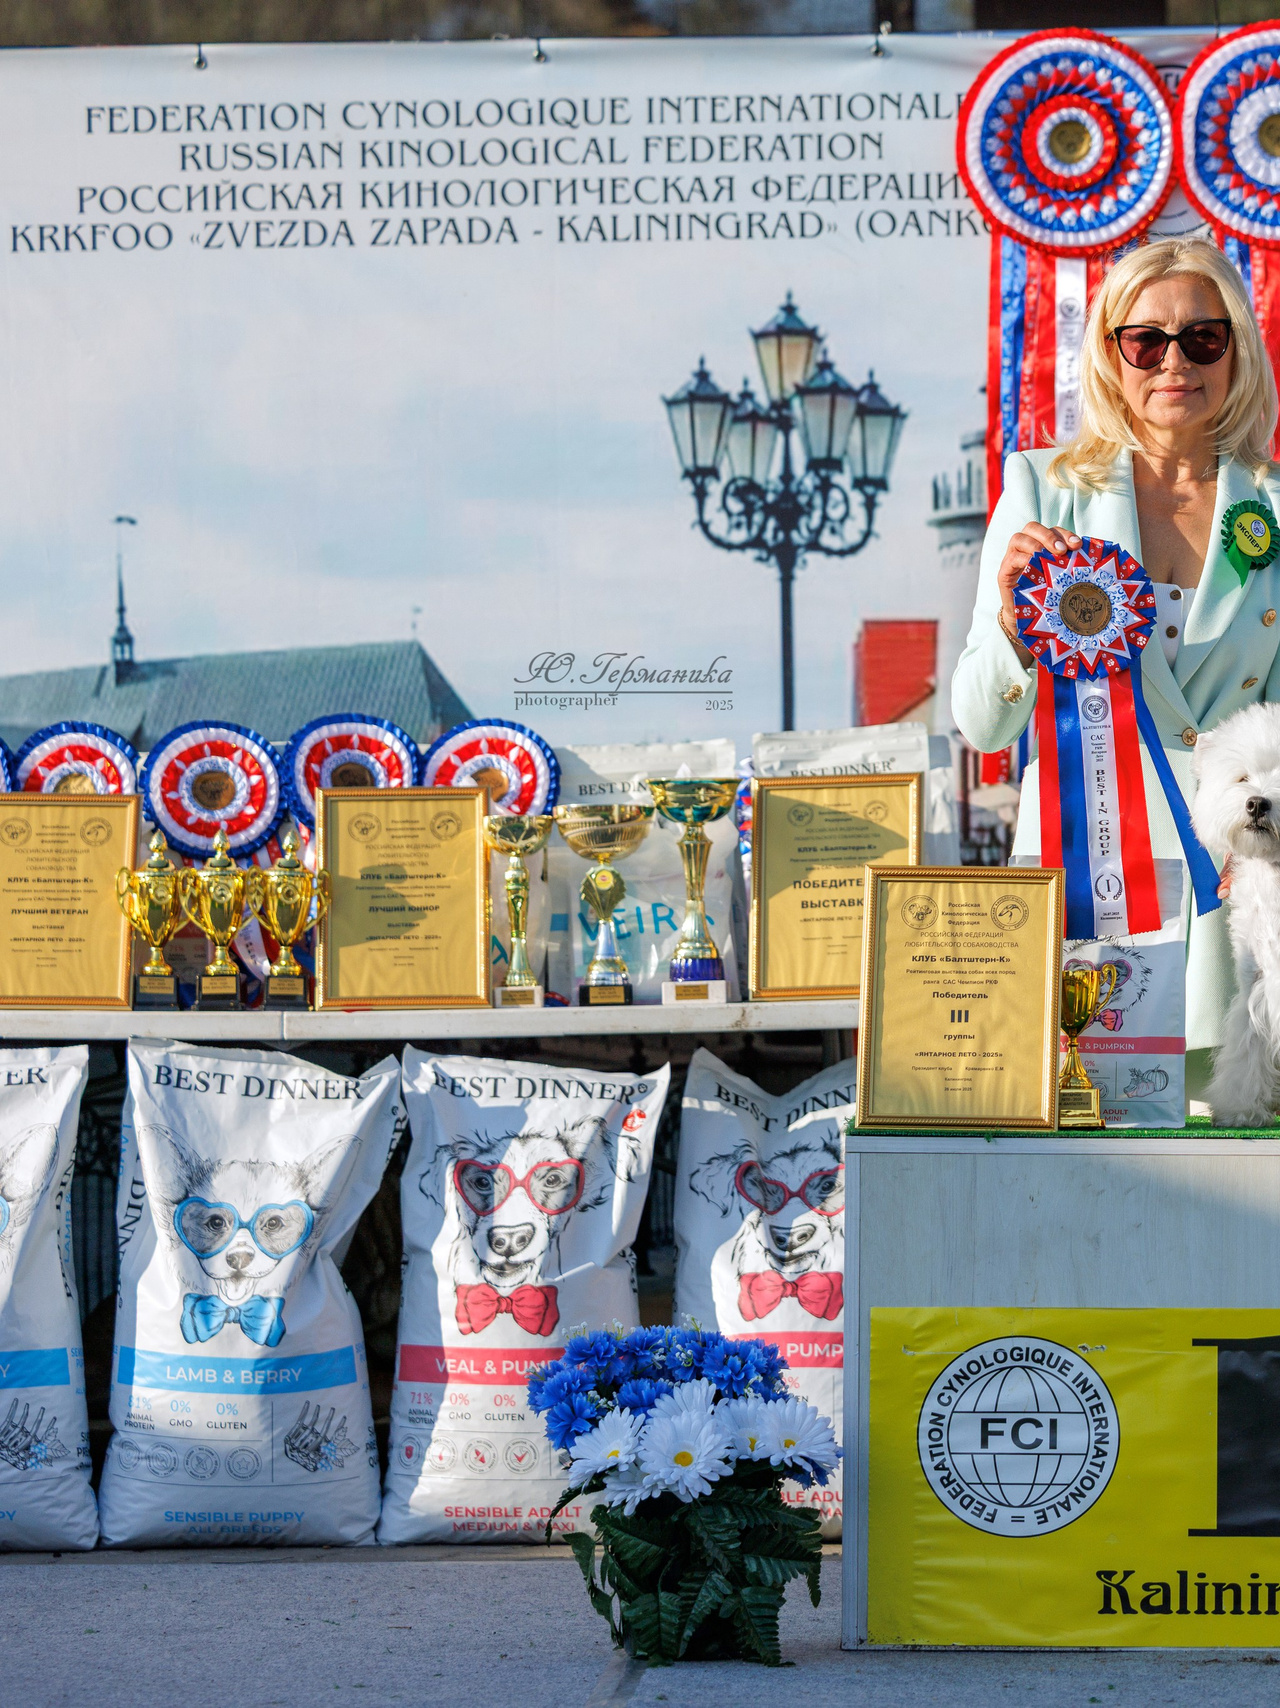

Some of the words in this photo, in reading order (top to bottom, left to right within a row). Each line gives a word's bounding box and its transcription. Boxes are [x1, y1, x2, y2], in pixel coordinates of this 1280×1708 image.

[86, 102, 327, 134] FEDERATION
[343, 96, 632, 133] CYNOLOGIQUE
[180, 142, 345, 172] RUSSIAN
[360, 136, 628, 169] KINOLOGICAL
[643, 132, 884, 164] FEDERATION
[78, 179, 343, 215] РОССИЙСКАЯ
[360, 173, 735, 211] КИНОЛОГИЧЕСКАЯ
[751, 173, 971, 206] ФЕДЕРАЦИ
[11, 223, 174, 253] KRKFOO
[190, 219, 356, 250] «ZVEZDA
[370, 216, 519, 247] ZAPADA
[557, 211, 838, 243] KALININGRAD»
[1236, 521, 1263, 553] ЭКСПЕРТ
[833, 760, 894, 776] DINNER
[578, 783, 617, 796] BEST
[1095, 770, 1106, 795] BEST
[1098, 802, 1108, 814] IN
[1098, 820, 1110, 856] GROUP
[793, 878, 864, 889] ПОБЕДИТЕ
[11, 907, 48, 915] ЛУЧШИЙ
[947, 919, 980, 927] Федерация
[964, 931, 1004, 939] ФЕДЕРАЦИЯ
[904, 941, 961, 949] ЛЮБИТЕЛЬСКОГО
[962, 941, 1019, 949] СОБАКОВОДСТВА
[911, 955, 937, 963] КЛУБ
[939, 955, 1011, 964] «Балтштерн-К»
[932, 991, 989, 999] Победитель
[950, 1009, 970, 1023] III
[943, 1033, 975, 1041] группы
[152, 1064, 234, 1095] BEST
[242, 1075, 364, 1100] DINNER
[433, 1071, 507, 1098] BEST
[515, 1077, 636, 1105] DINNER
[714, 1082, 777, 1132] BEST
[436, 1358, 480, 1374] VEAL
[484, 1360, 497, 1374] &
[166, 1365, 217, 1383] LAMB
[221, 1369, 236, 1383] &
[240, 1367, 303, 1384] BERRY
[936, 1346, 1074, 1407] CYNOLOGIQUE
[410, 1391, 433, 1405] 71%
[449, 1393, 470, 1405] 0%
[493, 1394, 516, 1407] 0%
[170, 1399, 191, 1413] 0%
[216, 1403, 239, 1416] 0%
[408, 1408, 433, 1416] ANIMAL
[449, 1411, 472, 1420] GMO
[485, 1412, 525, 1421] GLUTEN
[124, 1420, 155, 1430] PROTEIN
[126, 1412, 154, 1422] ANIMAL
[169, 1418, 193, 1428] GMO
[206, 1420, 248, 1430] GLUTEN
[408, 1416, 435, 1425] PROTEIN
[980, 1417, 1058, 1450] FCI
[1033, 1371, 1110, 1525] INTERNATIONALE
[928, 1411, 998, 1523] FEDERATION
[164, 1510, 244, 1523] SENSIBLE
[248, 1511, 305, 1524] PUPPY
[444, 1505, 524, 1518] SENSIBLE
[527, 1505, 582, 1518] ADULT
[187, 1525, 217, 1535] ALL
[220, 1524, 283, 1536] BREEDS
[452, 1521, 518, 1533] MEDIUM
[521, 1521, 532, 1532] &
[535, 1521, 575, 1532] MAXI
